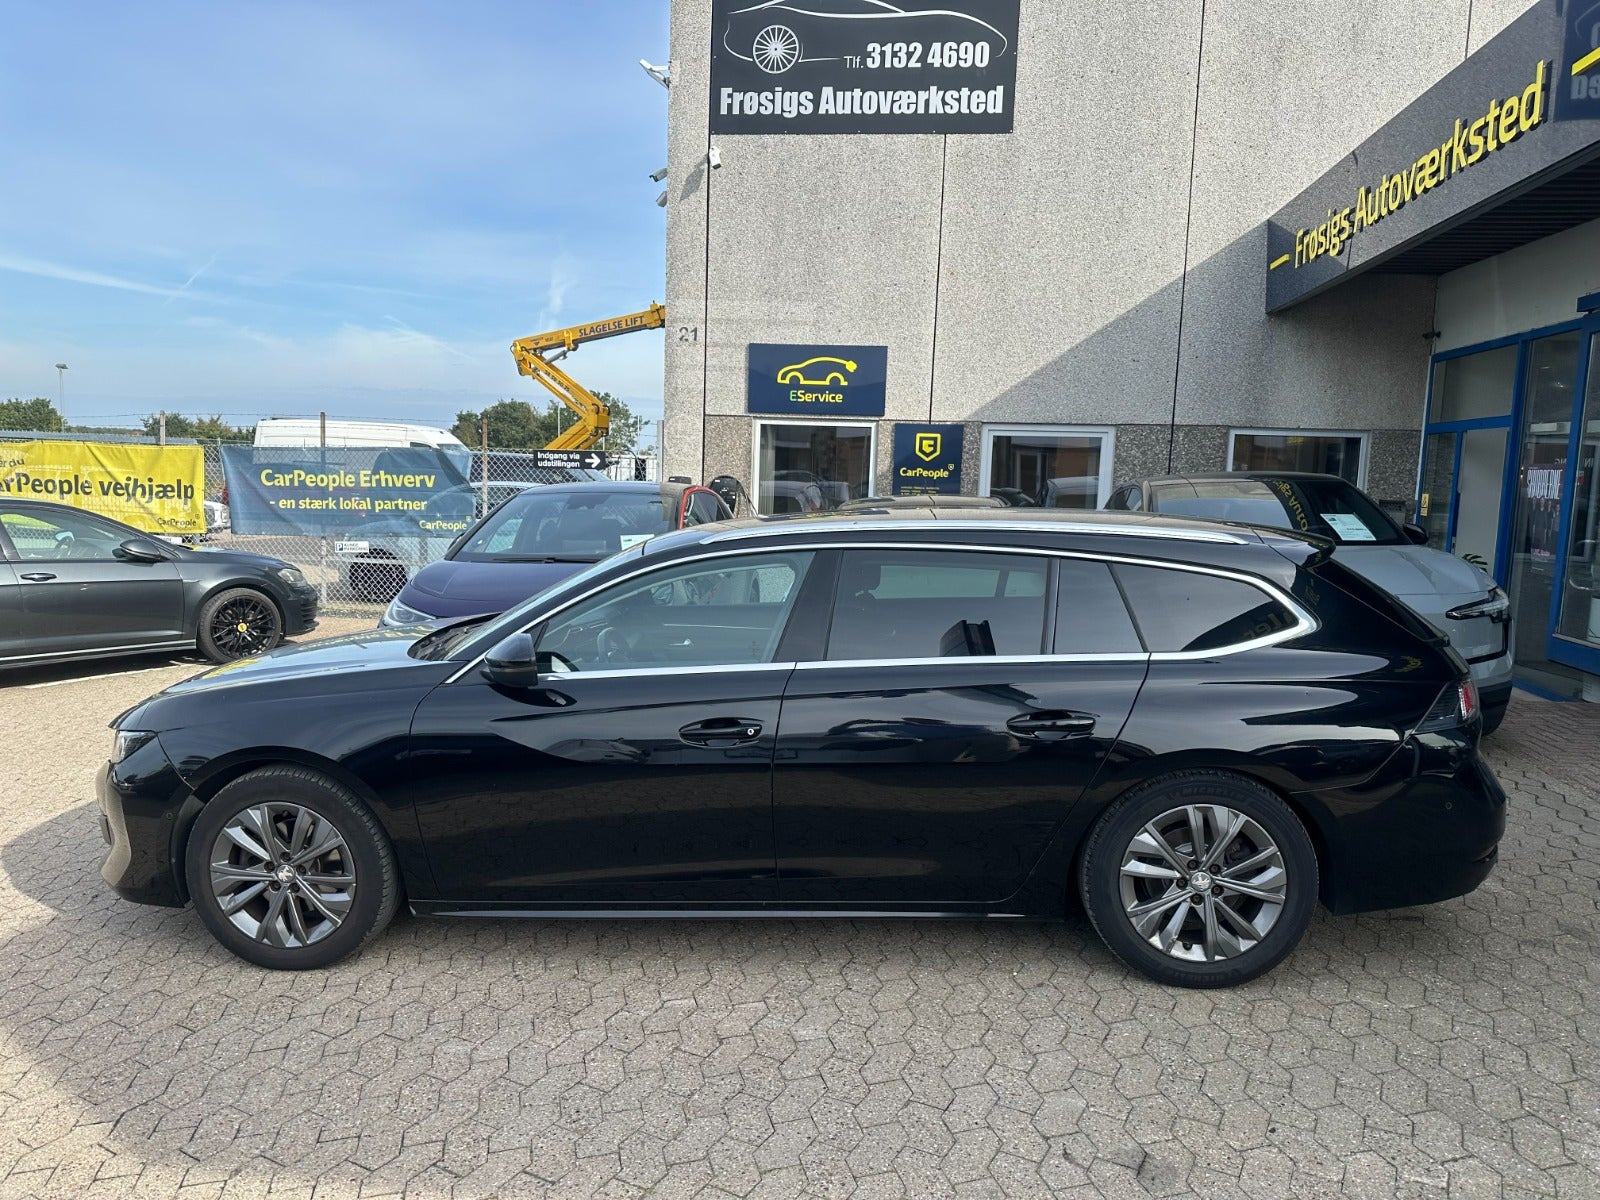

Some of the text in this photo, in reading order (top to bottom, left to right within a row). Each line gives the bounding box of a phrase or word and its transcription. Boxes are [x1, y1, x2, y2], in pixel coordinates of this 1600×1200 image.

[843, 41, 990, 69] Tlf. 3132 4690
[719, 85, 1004, 119] Frøsigs Autoværksted
[1294, 59, 1544, 268] Frøsigs Autoværksted
[578, 315, 644, 337] SLAGELSE LIFT
[679, 326, 698, 342] 21
[789, 389, 843, 403] EService
[537, 451, 580, 460] Indgang via
[537, 460, 580, 468] udstillingen
[260, 468, 436, 491] CarPeople Erhverv
[899, 467, 949, 480] CarPeople
[279, 499, 296, 509] en
[298, 497, 337, 510] stærk
[340, 497, 371, 510] lokal
[375, 498, 427, 512] partner
[157, 517, 197, 529] CarPeople
[418, 519, 468, 532] CarPeople
